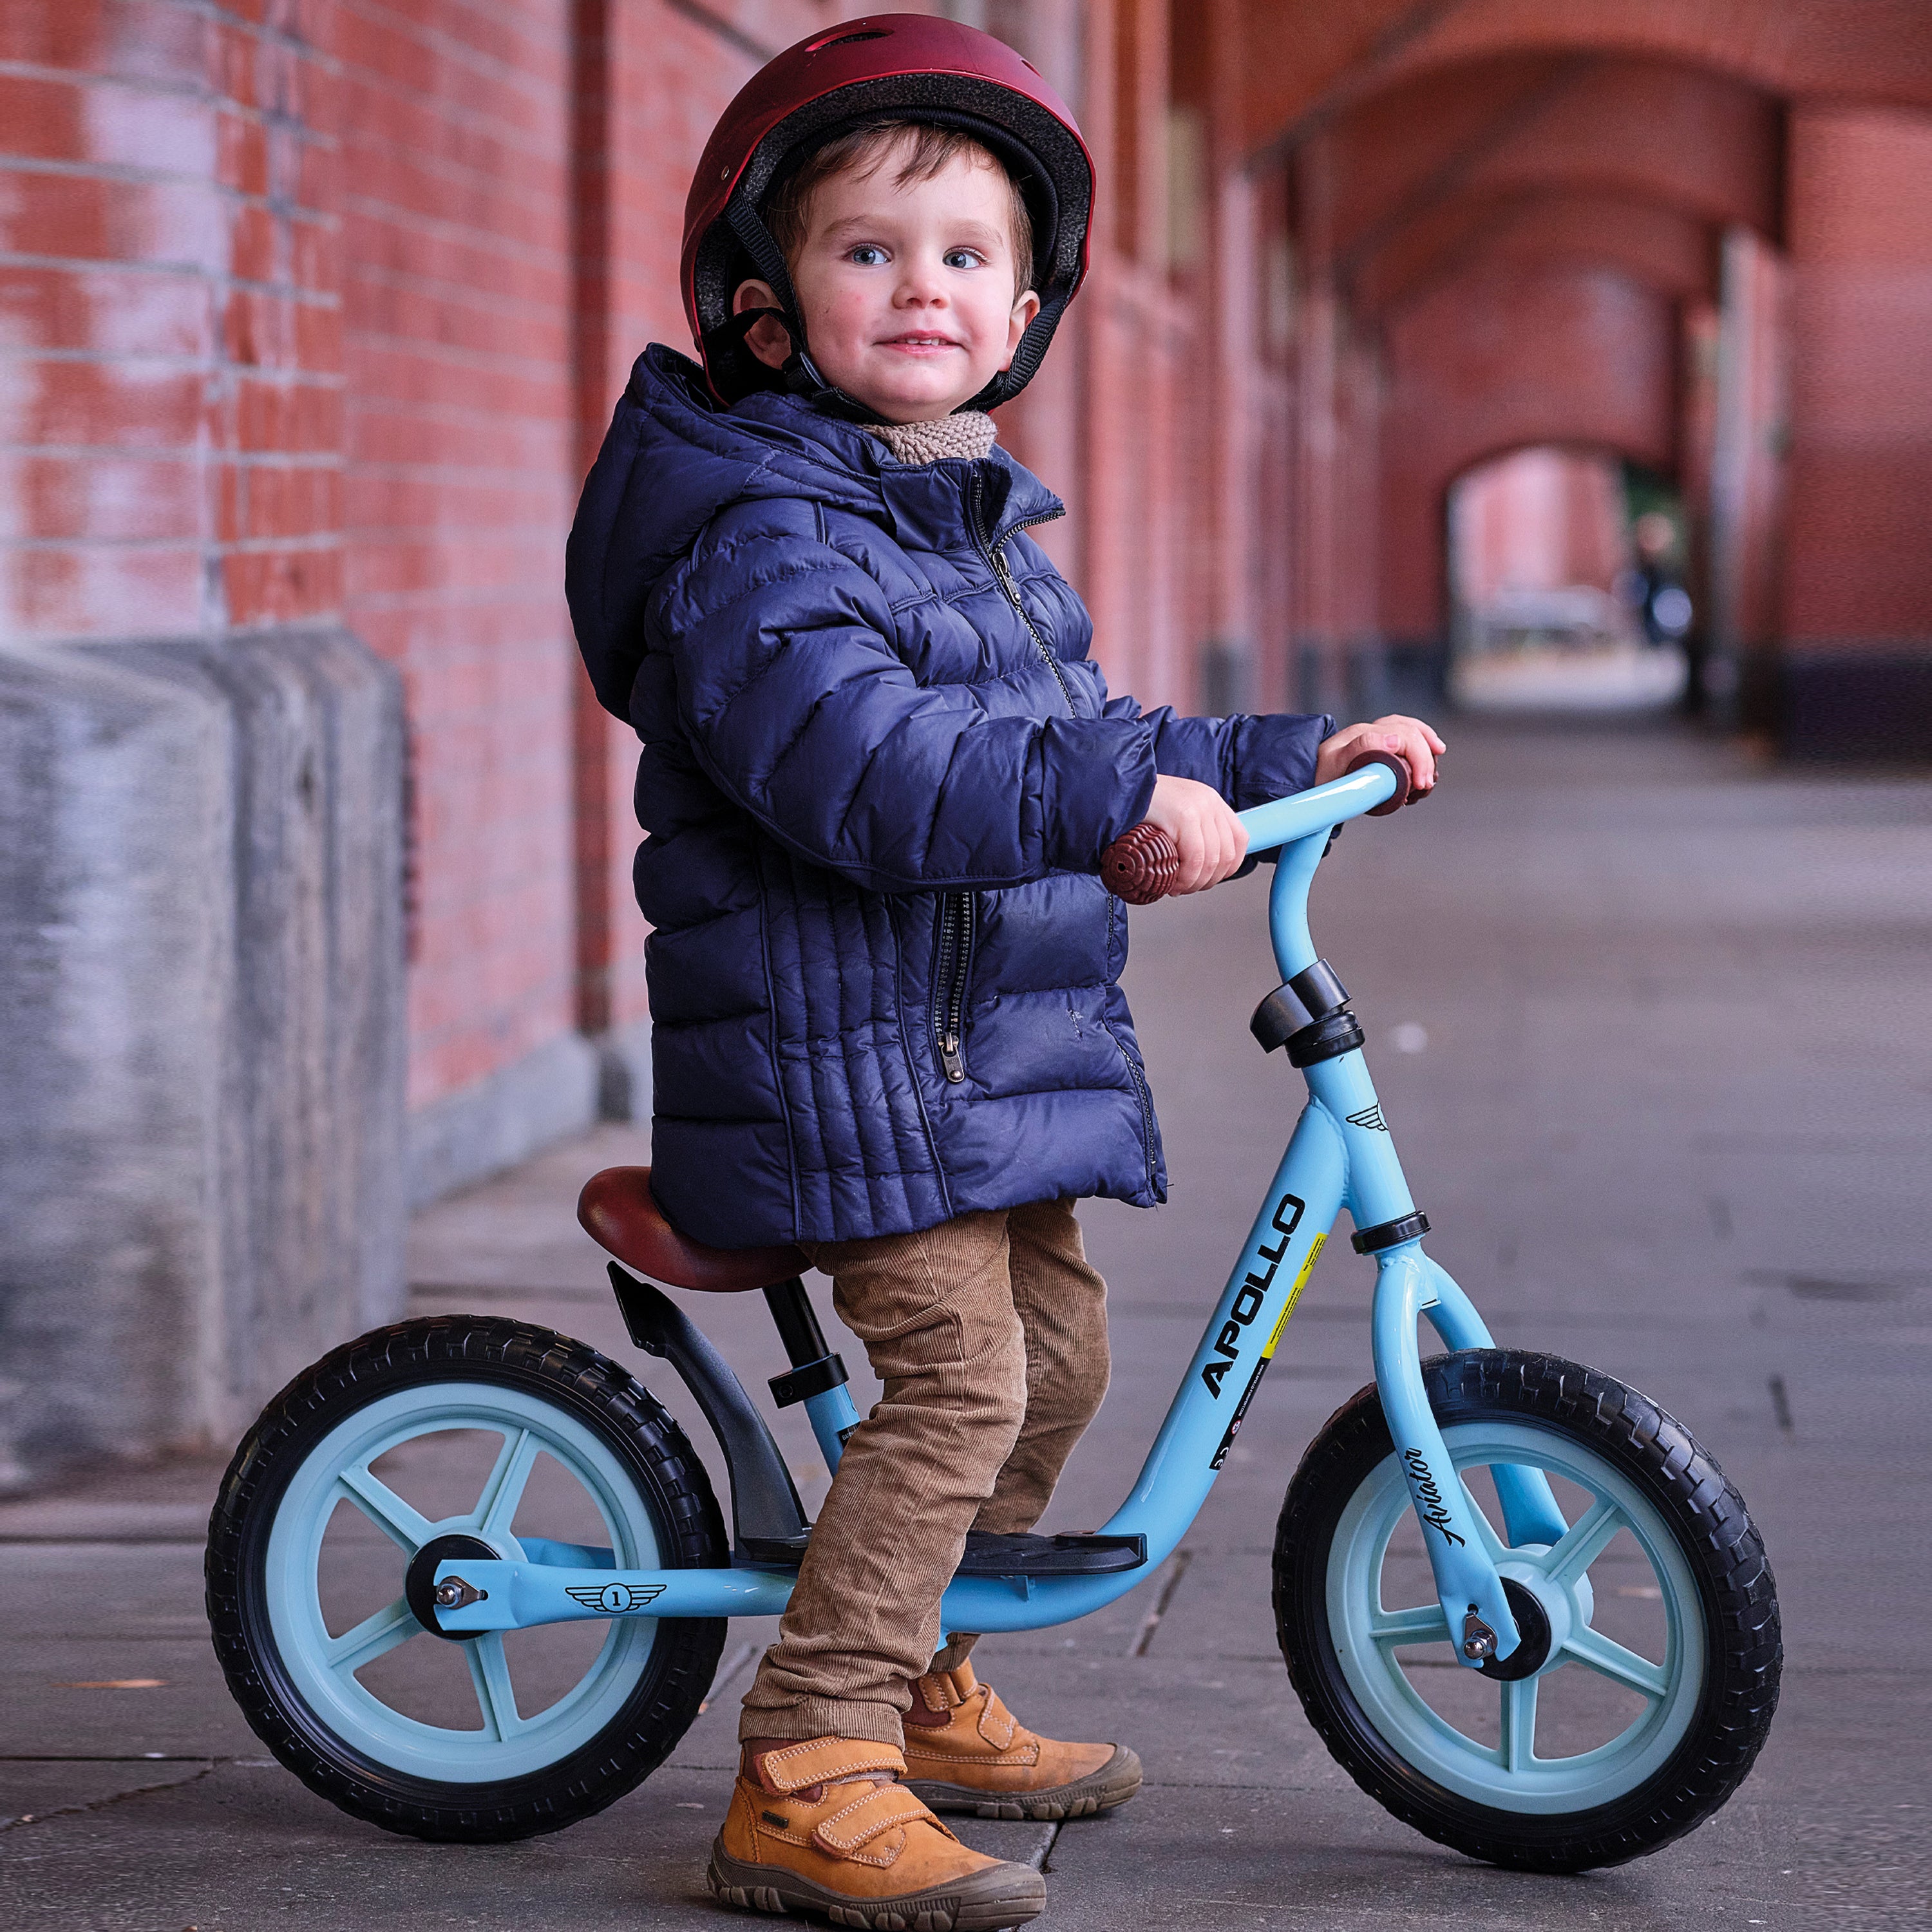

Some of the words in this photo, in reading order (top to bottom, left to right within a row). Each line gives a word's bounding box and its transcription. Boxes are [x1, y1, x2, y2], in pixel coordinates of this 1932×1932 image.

[1201, 1193, 1305, 1400] APOLLO
[1405, 1447, 1465, 1548] Aviator
[612, 1591, 621, 1606] 1
